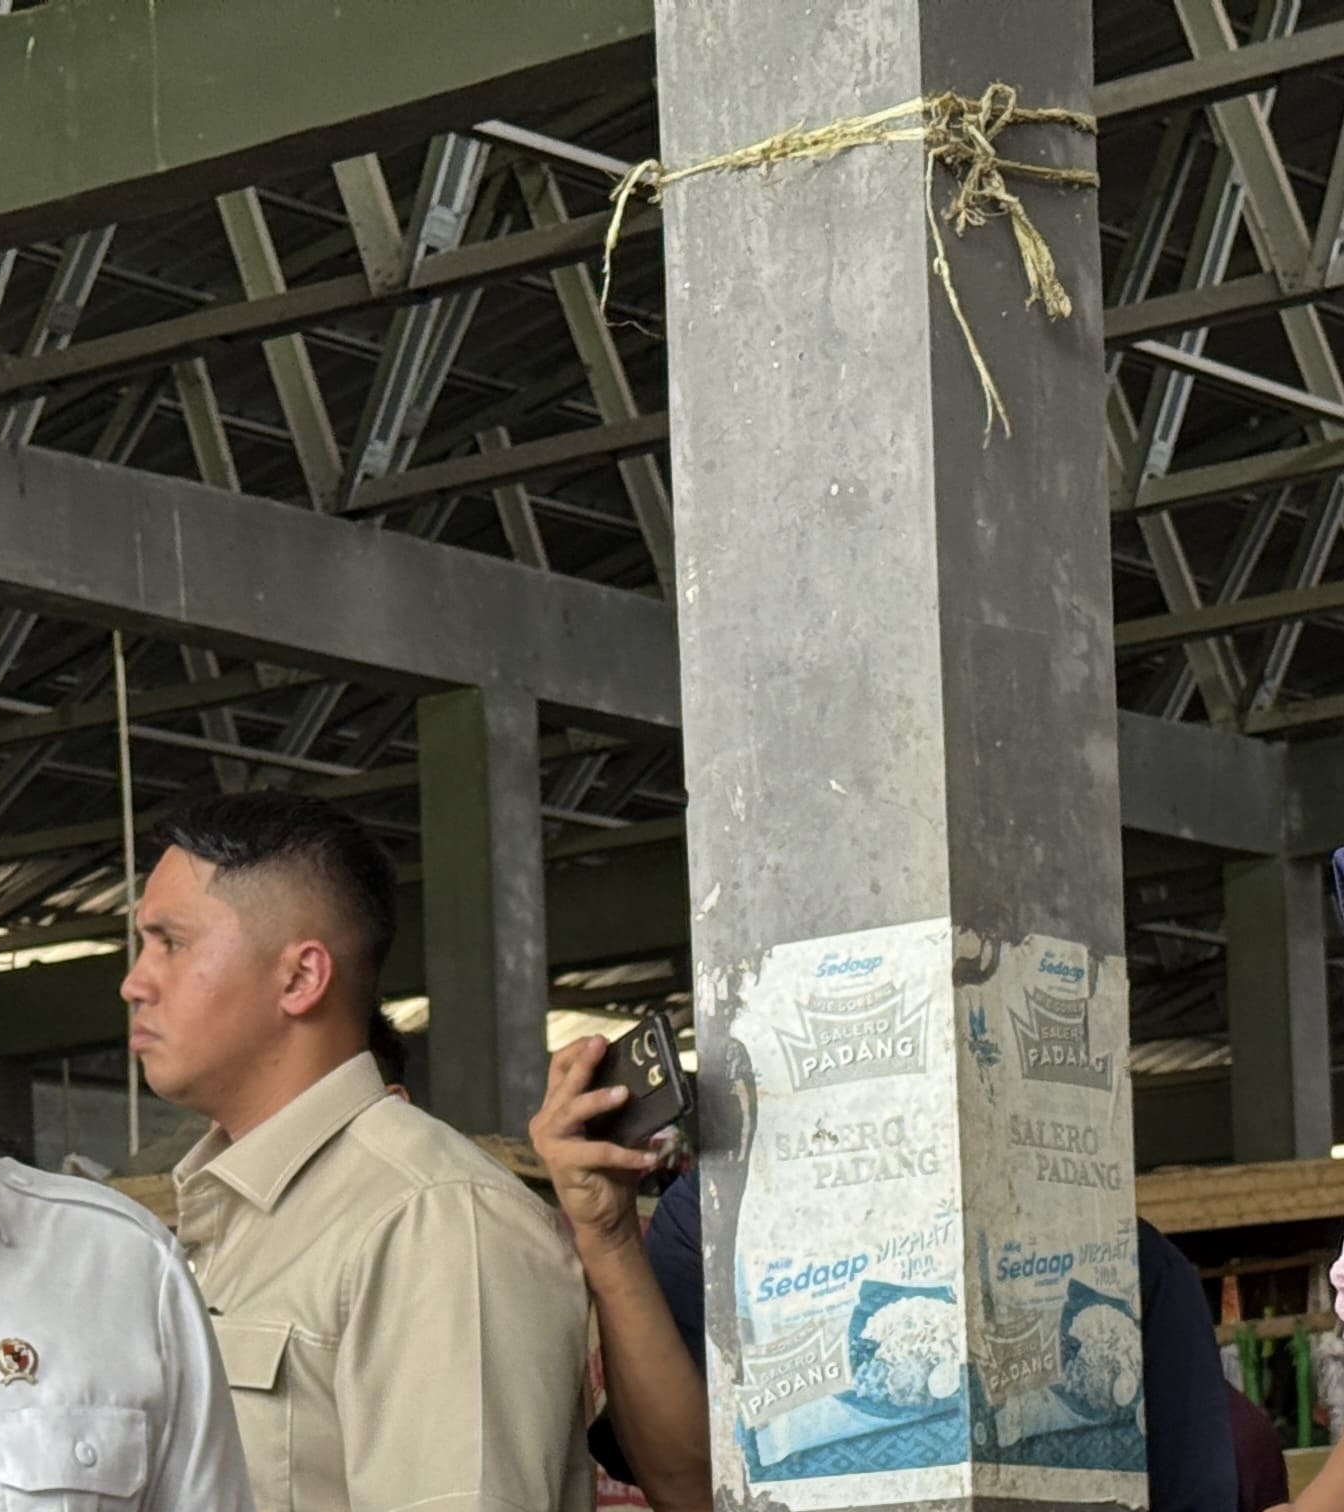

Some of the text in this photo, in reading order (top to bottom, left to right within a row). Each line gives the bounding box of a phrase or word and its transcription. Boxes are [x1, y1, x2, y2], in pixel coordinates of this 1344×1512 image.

[815, 956, 884, 978] Sedaap
[819, 1018, 890, 1045] SALERO
[801, 1036, 915, 1080] PADANG
[775, 1114, 909, 1162] SALERO
[1009, 1113, 1099, 1156] SALERO
[812, 1145, 942, 1190] PADANG
[1035, 1152, 1122, 1191] PADANG
[756, 1253, 869, 1302] Sedaap
[996, 1251, 1074, 1281] Sedaap
[748, 1360, 842, 1415] PADANG
[989, 1353, 1056, 1392] PADANG
